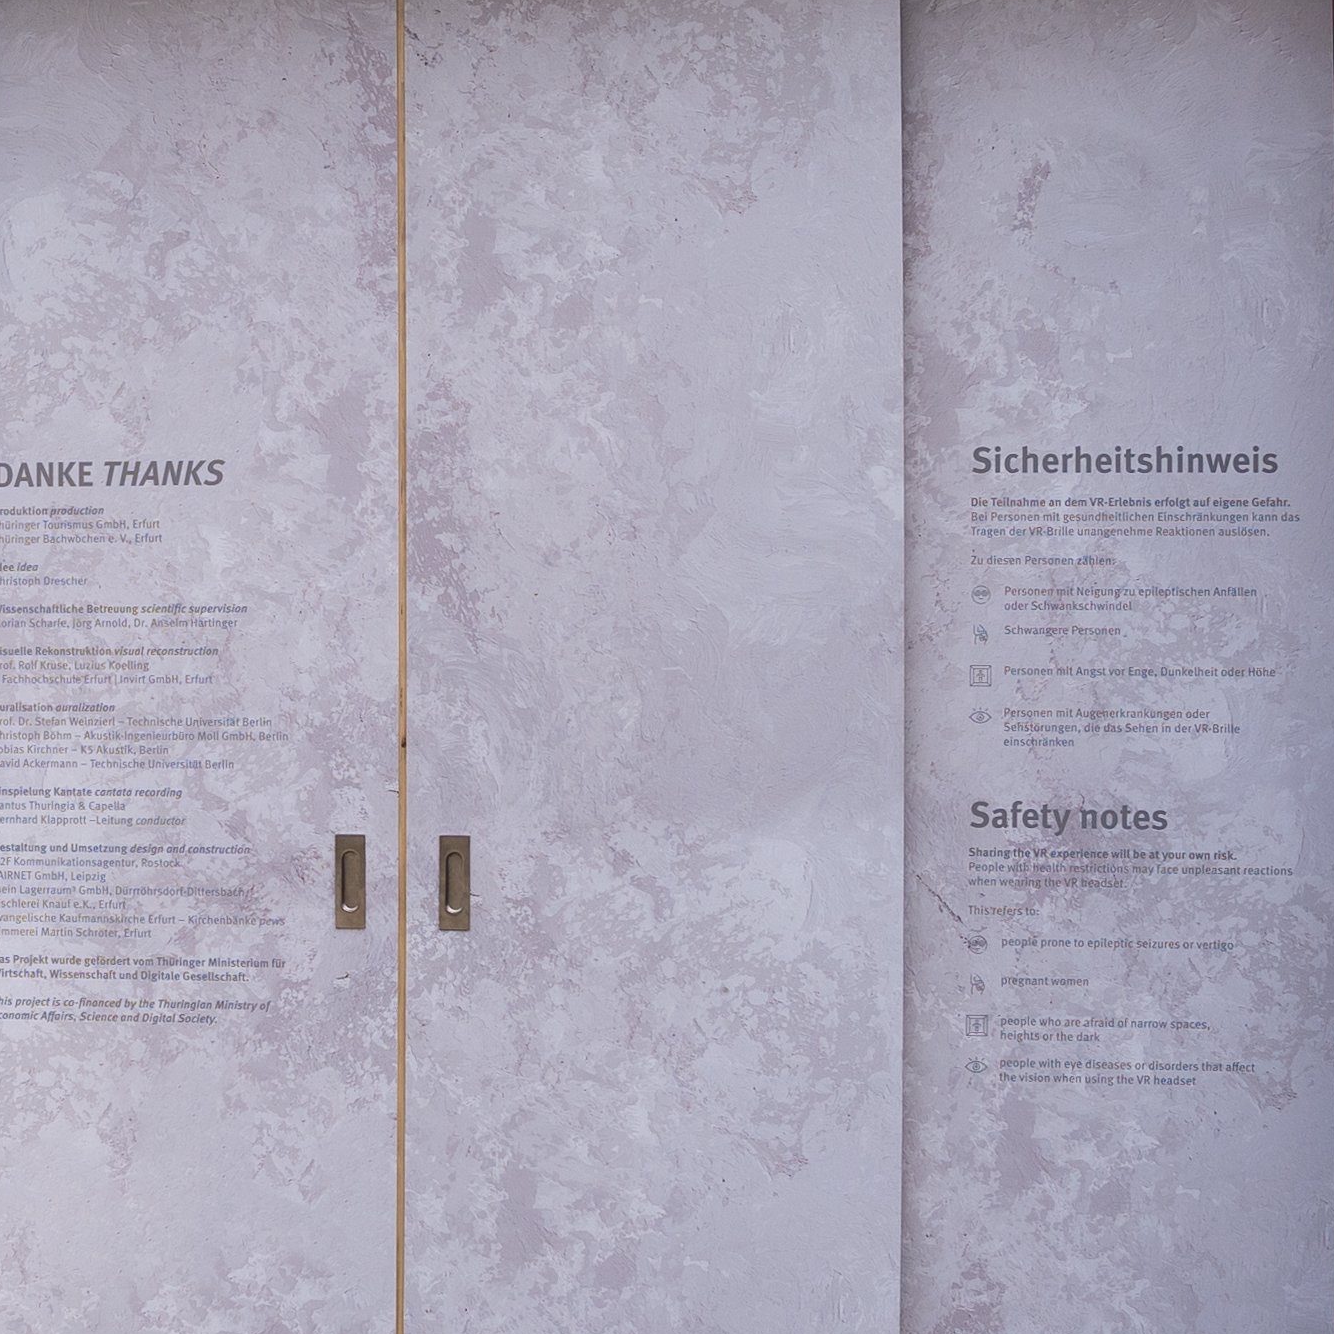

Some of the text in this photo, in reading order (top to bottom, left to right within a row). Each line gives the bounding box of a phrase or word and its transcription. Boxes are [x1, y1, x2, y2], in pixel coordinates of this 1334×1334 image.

[972, 446, 1278, 474] Sicherheitshinweis
[103, 459, 225, 486] THANKS
[971, 498, 988, 507] Die
[991, 497, 1045, 507] Teilnahme
[1065, 497, 1087, 507] dem
[1090, 497, 1151, 507] VR-Erlebnis
[1155, 497, 1190, 510] erfolgt
[1194, 497, 1210, 507] auf
[1213, 497, 1249, 510] eigene
[1252, 497, 1290, 507] Gefahr.
[51, 506, 104, 517] production
[17, 562, 38, 572] idea
[87, 604, 138, 616] Betreuung
[141, 604, 186, 616] scientific
[189, 604, 247, 616] supervision
[1004, 625, 1121, 637] Schwangere Personen
[35, 646, 111, 656] Rekonstruktion
[114, 646, 144, 656] visual
[147, 646, 219, 656] reconstruction
[56, 703, 115, 712] auralization
[54, 787, 92, 797] Kantate
[95, 788, 131, 797] cantata
[134, 788, 182, 799] recording
[970, 801, 1168, 836] Safety notes
[969, 847, 1010, 860] Sharing
[1013, 848, 1030, 858] the
[1033, 849, 1047, 858] VR
[1051, 849, 1108, 861] experience
[1111, 849, 1130, 859] will
[1133, 849, 1146, 859] be
[1149, 850, 1159, 859] at
[1162, 853, 1185, 862] your
[1214, 850, 1237, 860] risk.
[1001, 977, 1089, 988] pregnant women
